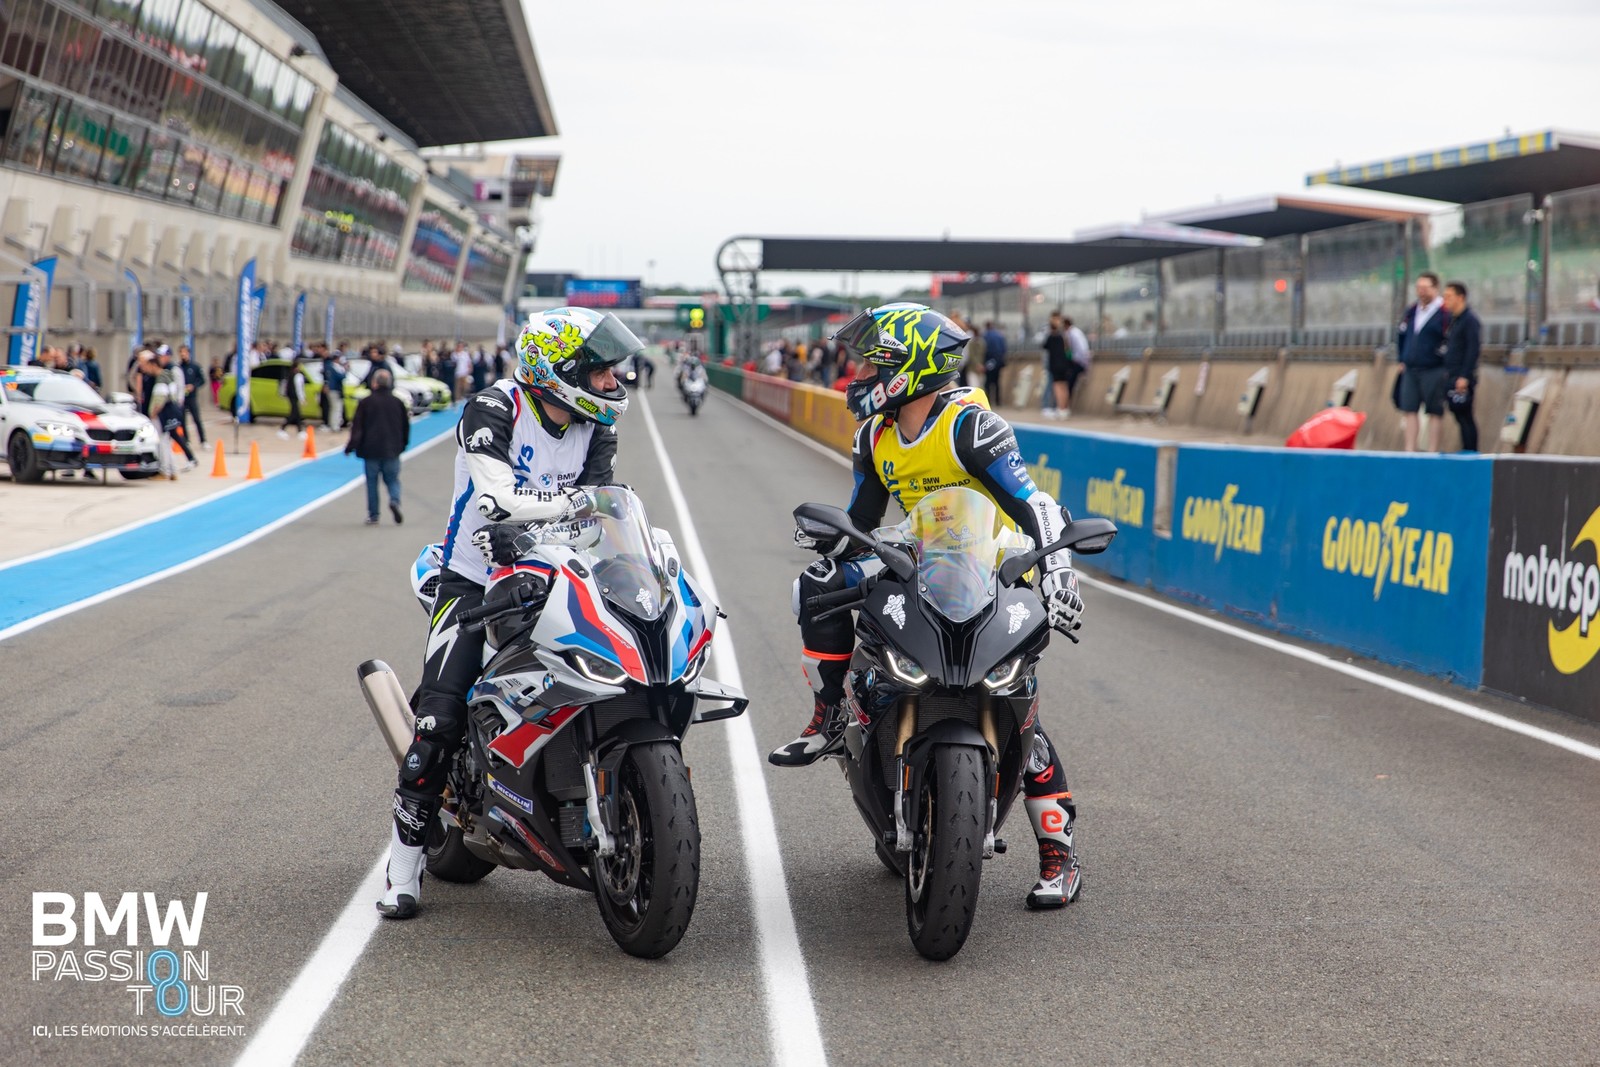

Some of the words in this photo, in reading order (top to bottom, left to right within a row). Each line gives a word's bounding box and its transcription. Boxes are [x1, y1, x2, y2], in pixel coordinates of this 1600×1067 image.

[859, 382, 887, 416] 78
[889, 377, 907, 394] BELL
[577, 398, 598, 413] SHOEI
[557, 471, 577, 481] BMW
[922, 476, 940, 485] BMW
[1038, 500, 1053, 544] MOTORRAD
[1182, 495, 1265, 556] GOODYEAR
[1322, 513, 1453, 597] GOODYEAR
[1503, 544, 1600, 633] motorsp
[496, 784, 530, 808] MICHELIN
